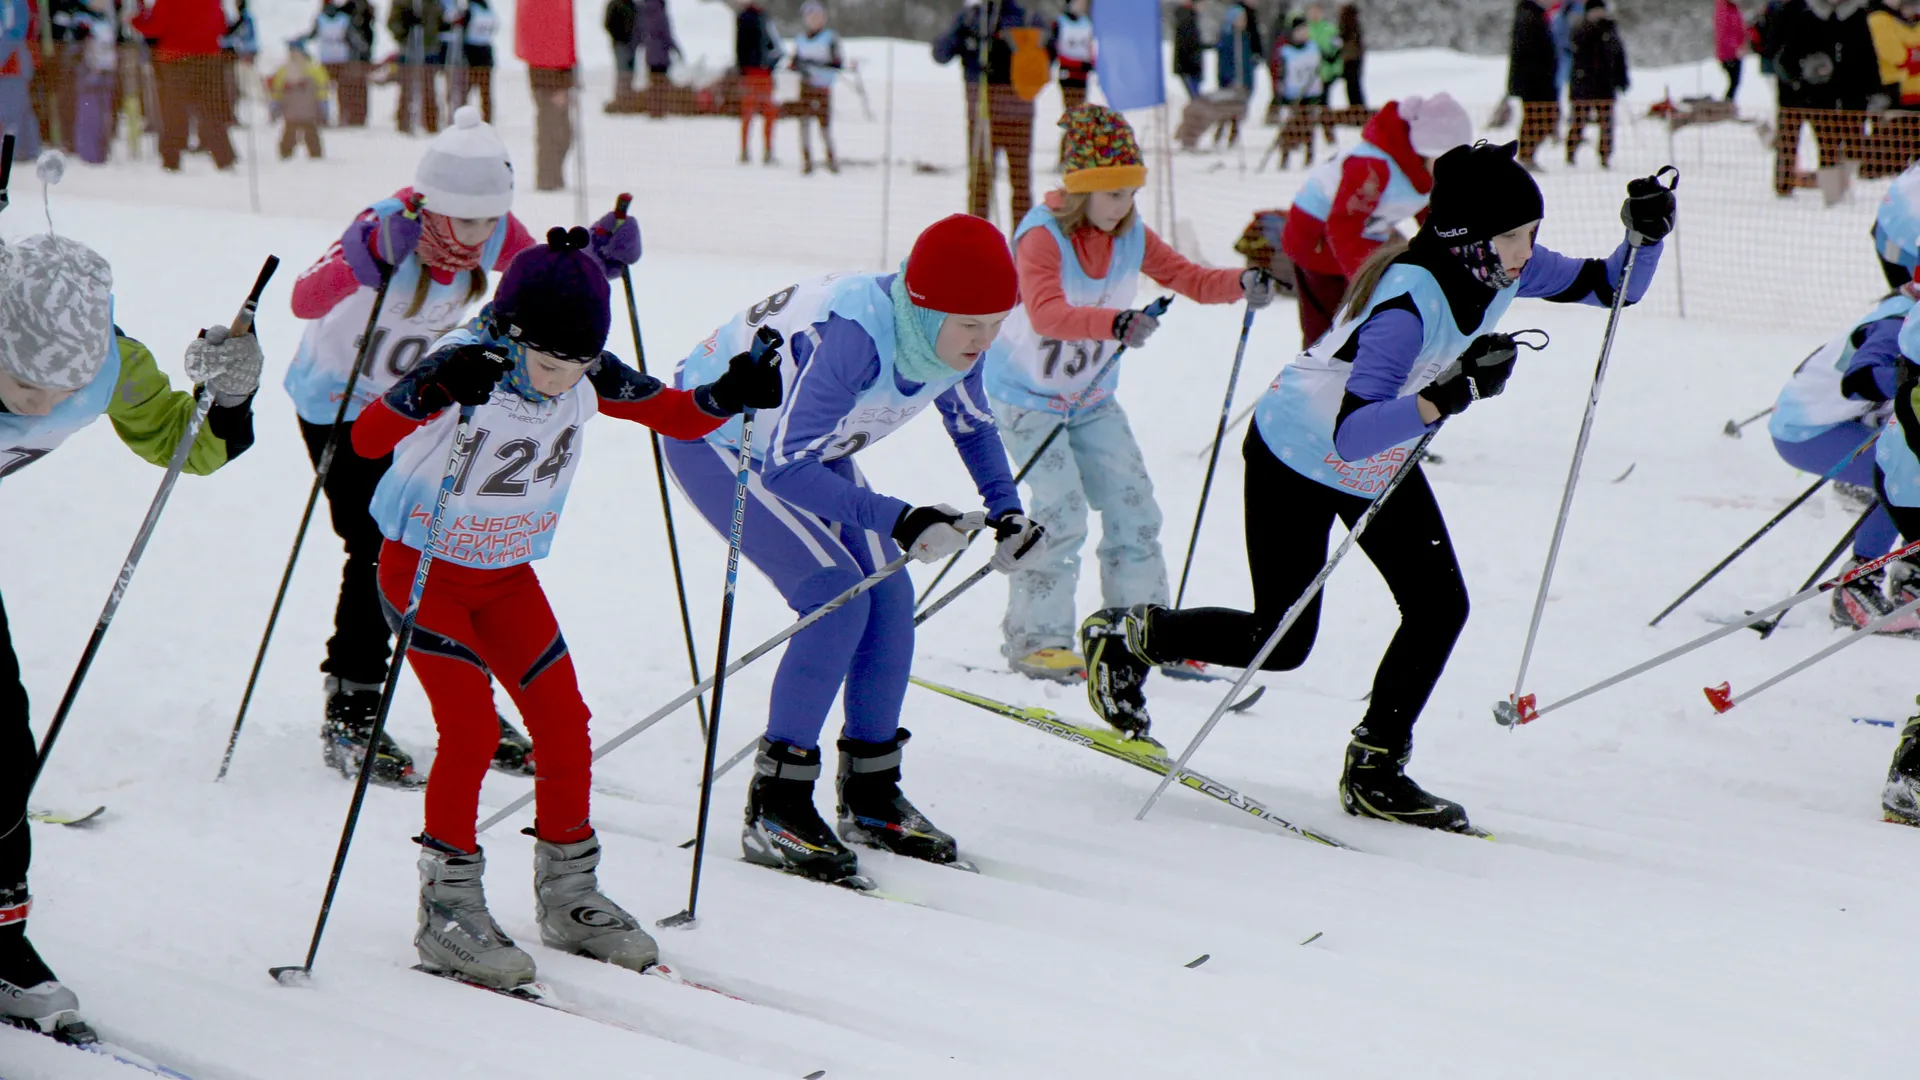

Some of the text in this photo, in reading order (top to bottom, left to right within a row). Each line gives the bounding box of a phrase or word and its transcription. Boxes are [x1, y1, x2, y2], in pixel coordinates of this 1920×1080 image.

[452, 424, 579, 497] 124
[452, 510, 535, 532] КУБОК
[434, 538, 532, 564] ДОЛИНЫ
[1024, 718, 1095, 747] FISCHER
[767, 830, 814, 855] SALOMON
